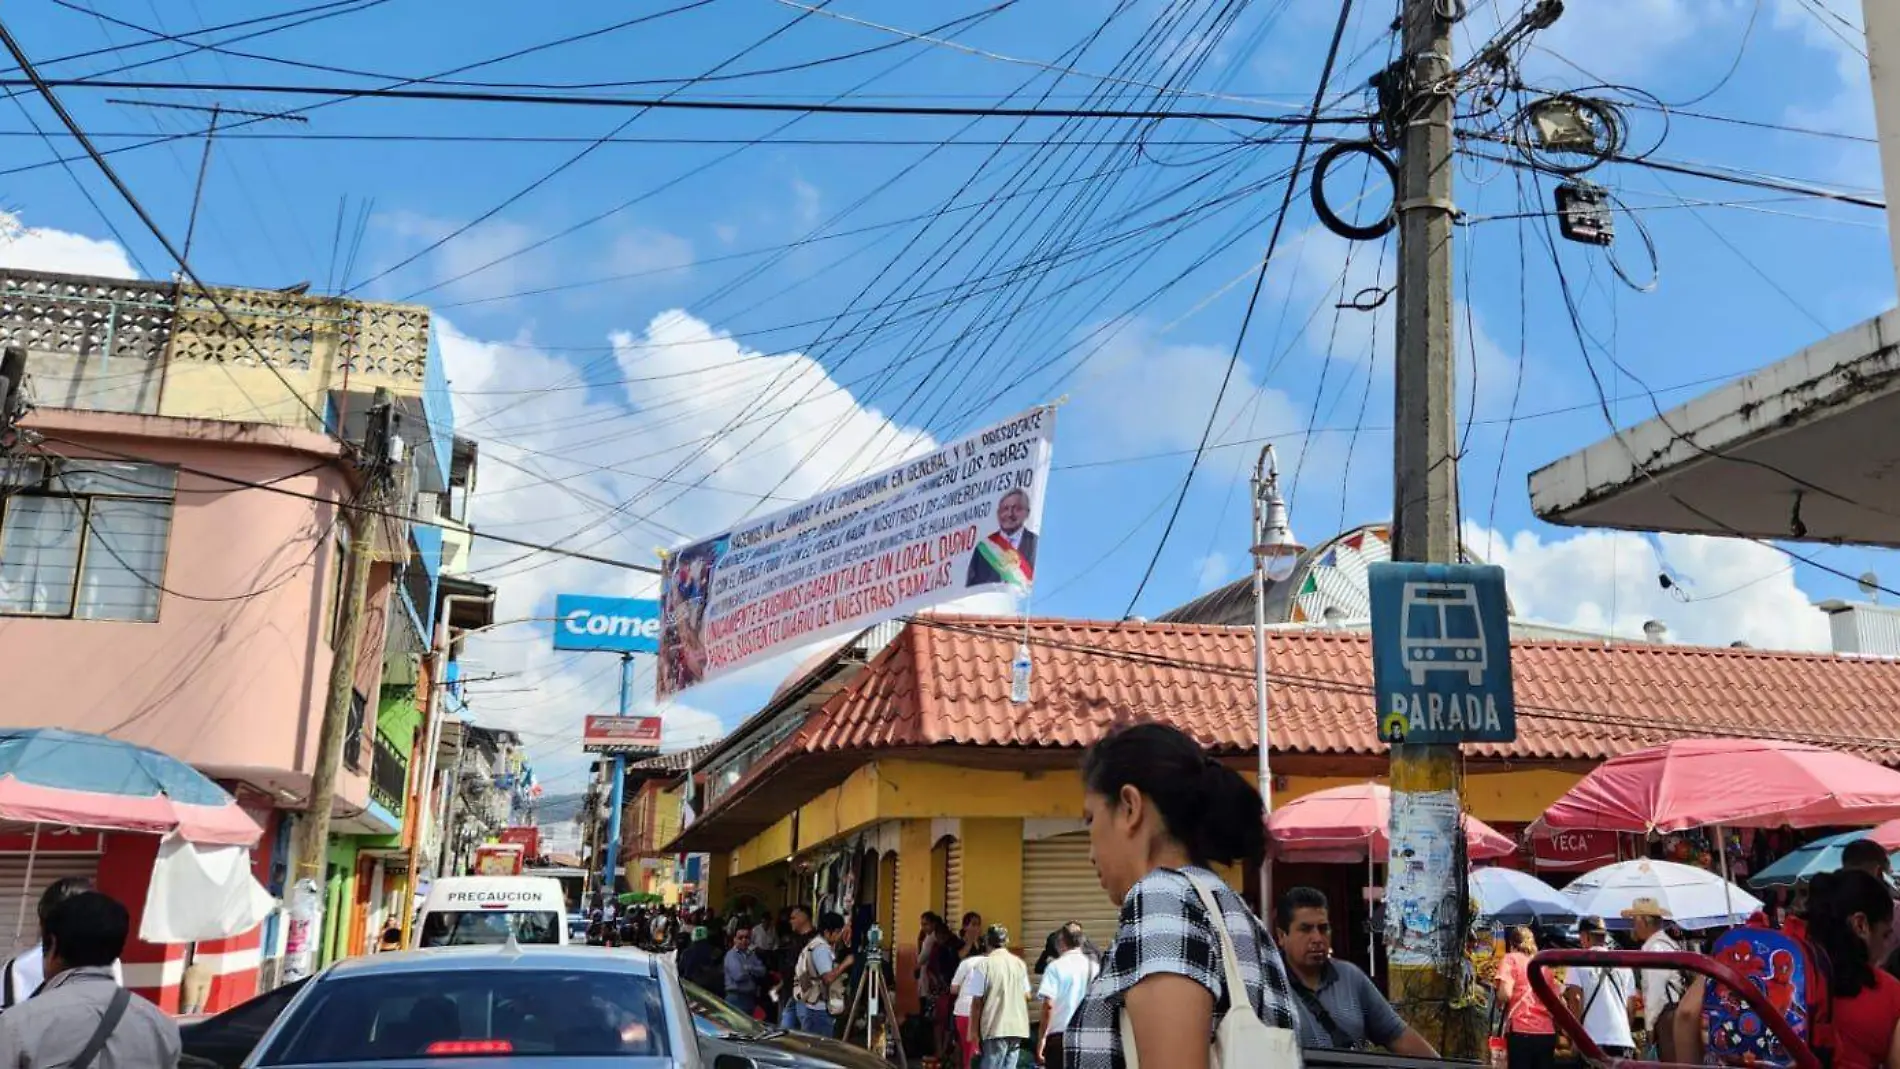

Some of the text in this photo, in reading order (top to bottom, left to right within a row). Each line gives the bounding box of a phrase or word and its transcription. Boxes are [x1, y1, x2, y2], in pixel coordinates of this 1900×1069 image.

[906, 447, 951, 482] GENERAL
[1014, 464, 1034, 492] NO
[858, 558, 875, 586] DE
[876, 551, 893, 580] UN
[896, 536, 937, 575] LOCAL
[938, 523, 977, 560] DIGNO
[816, 600, 832, 628] DE
[832, 578, 897, 626] NUESTRAS
[1391, 693, 1501, 731] PARADA
[448, 892, 542, 901] PRECAUCION
